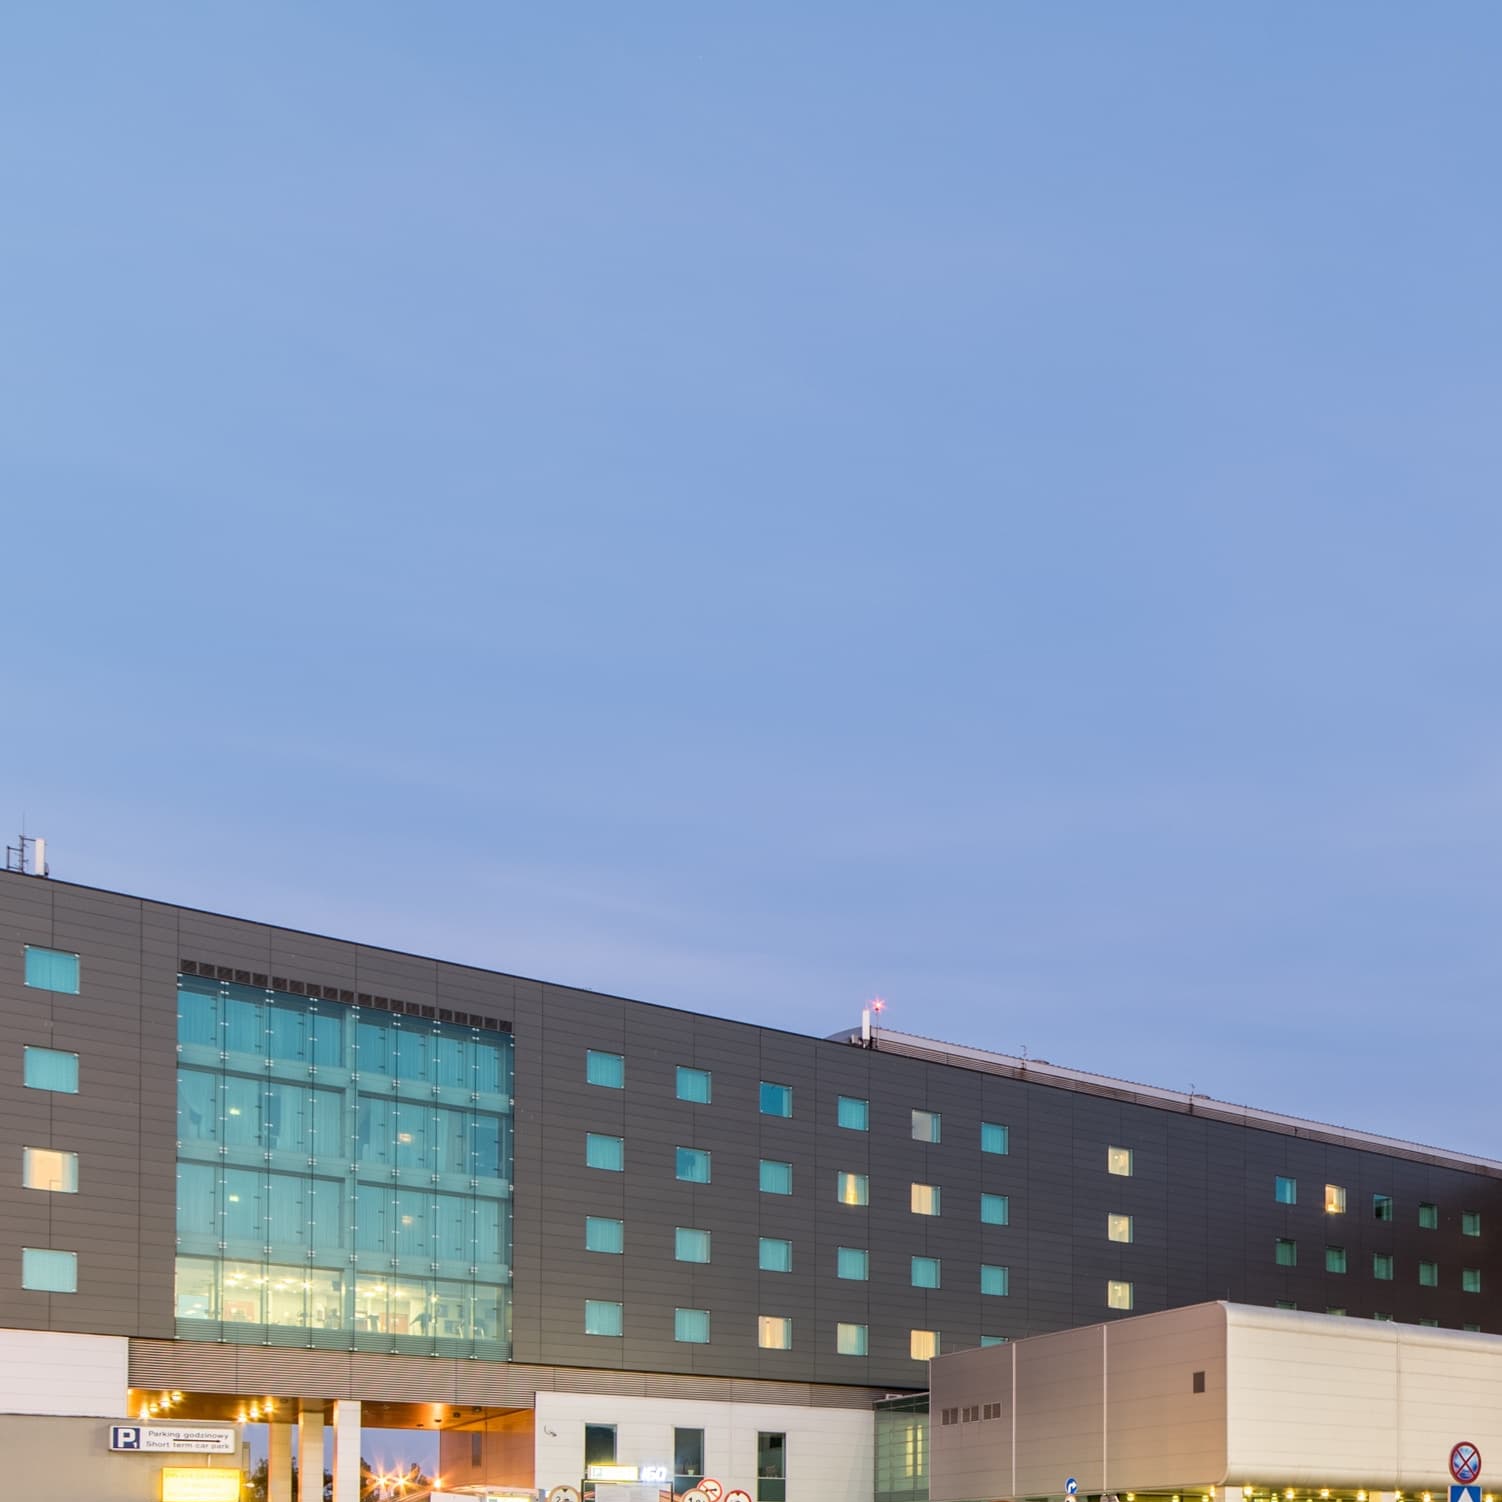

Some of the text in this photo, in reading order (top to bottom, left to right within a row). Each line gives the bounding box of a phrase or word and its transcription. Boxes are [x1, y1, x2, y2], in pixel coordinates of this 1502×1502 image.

[148, 1430, 229, 1440] Parking godzinowy
[146, 1440, 170, 1448] Short
[173, 1441, 193, 1449] term
[211, 1442, 229, 1450] park
